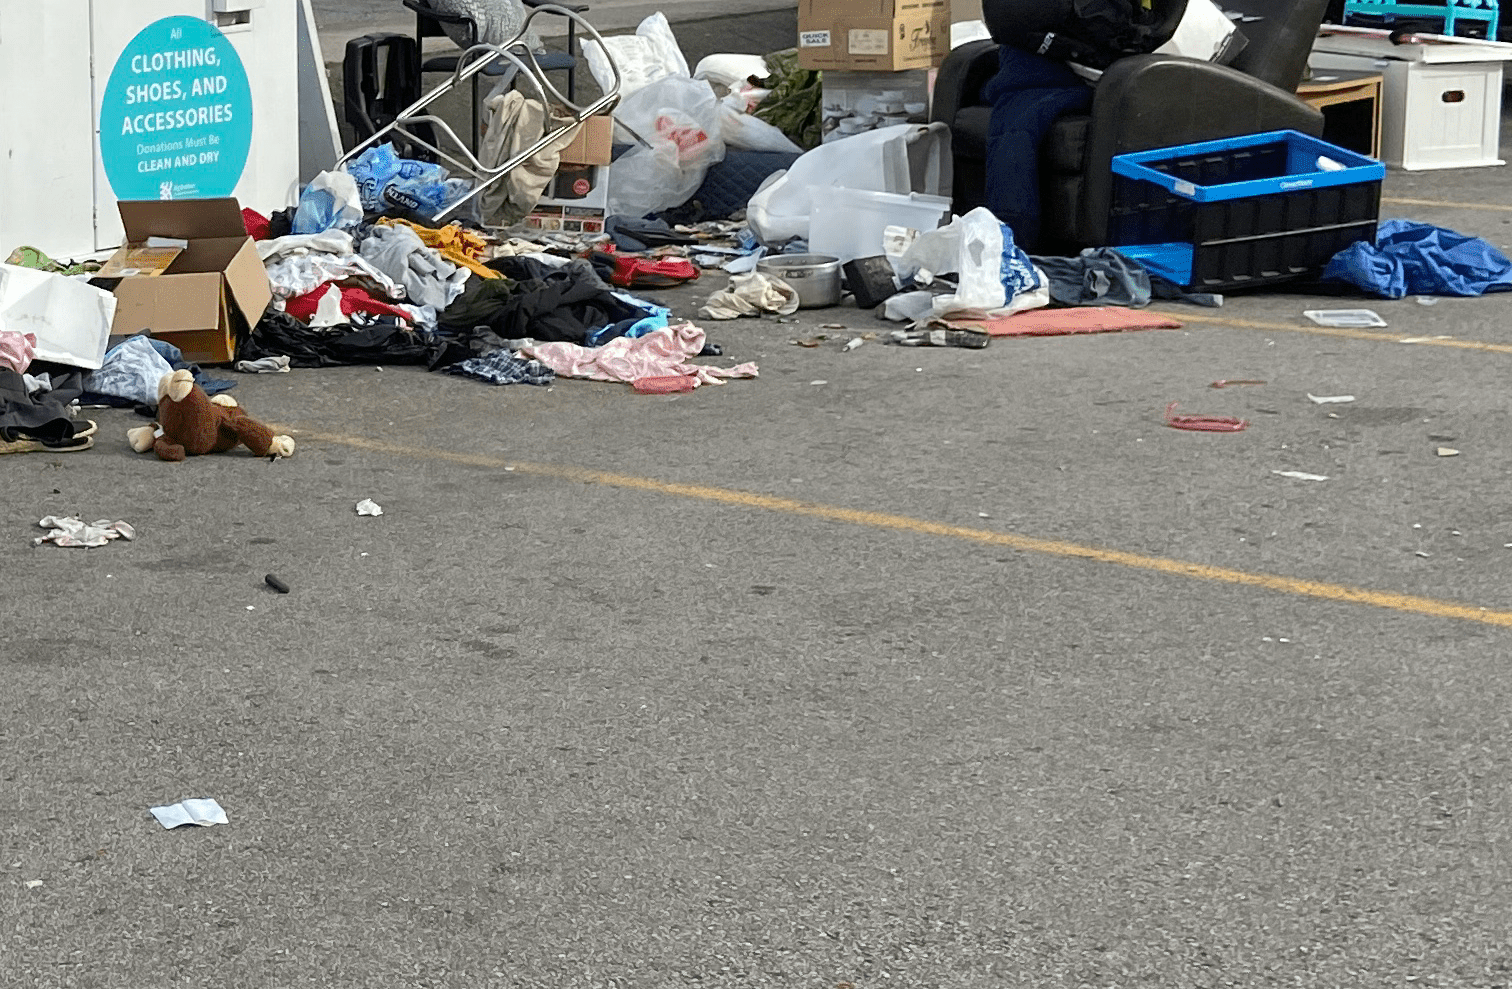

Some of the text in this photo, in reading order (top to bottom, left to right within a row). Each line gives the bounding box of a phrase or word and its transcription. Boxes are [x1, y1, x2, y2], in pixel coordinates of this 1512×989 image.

[131, 47, 221, 74] CLOTHING,
[126, 75, 228, 105] SHOES, AND
[121, 103, 233, 136] ACCESSORIES
[136, 134, 220, 156] Donations Must Be
[138, 150, 220, 173] CLEAN AND DRY
